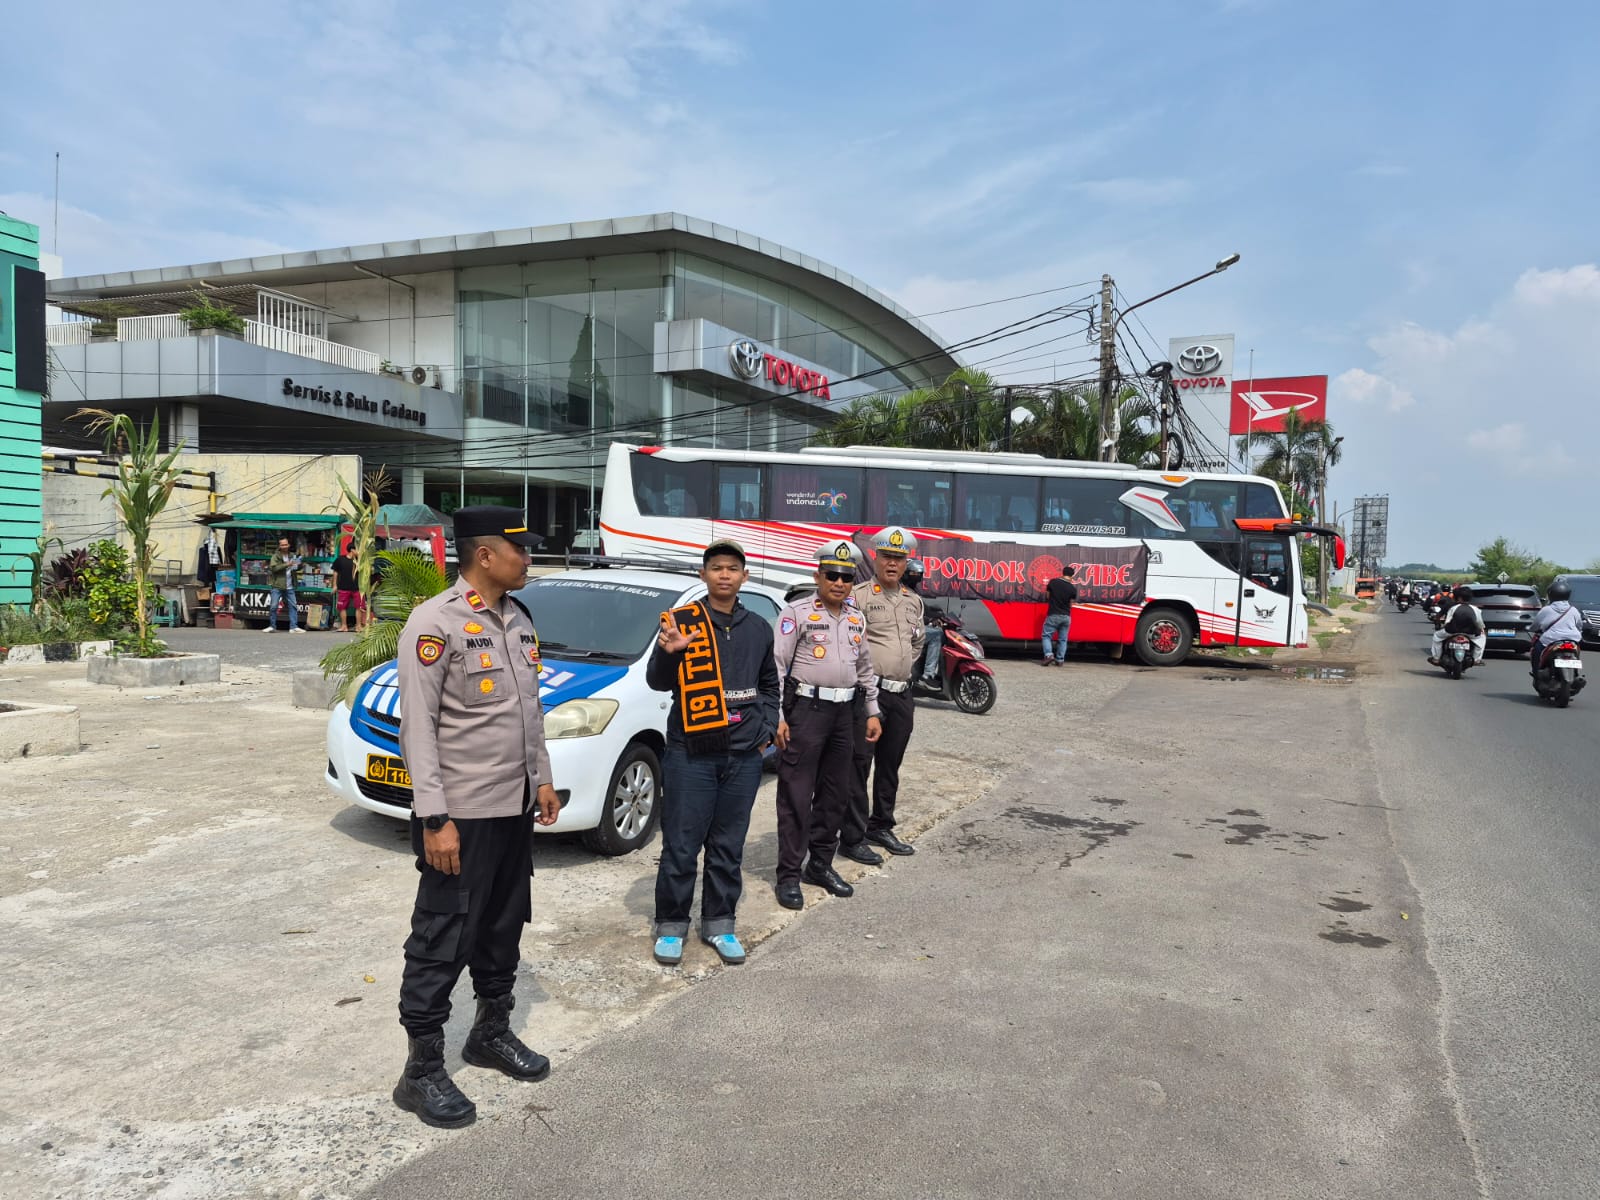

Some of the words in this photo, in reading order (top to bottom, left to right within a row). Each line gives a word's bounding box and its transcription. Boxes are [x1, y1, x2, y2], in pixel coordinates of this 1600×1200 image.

[763, 352, 830, 401] TOYOTA
[1172, 377, 1226, 390] TOYOTA
[283, 377, 331, 403] Servis
[332, 390, 343, 406] &
[346, 391, 377, 413] Suku
[382, 399, 426, 426] Cadang
[1199, 461, 1226, 469] Toyota
[786, 498, 825, 506] indonesia
[1041, 523, 1064, 532] BUS
[1065, 525, 1126, 535] PARIWISATA
[922, 556, 1026, 584] PONDOK
[921, 581, 941, 591] LY
[950, 581, 995, 595] WITH
[1004, 583, 1026, 595] US
[240, 592, 272, 608] KIKA
[466, 638, 494, 649] MUDI
[679, 621, 714, 680] THE
[689, 694, 720, 721] 19
